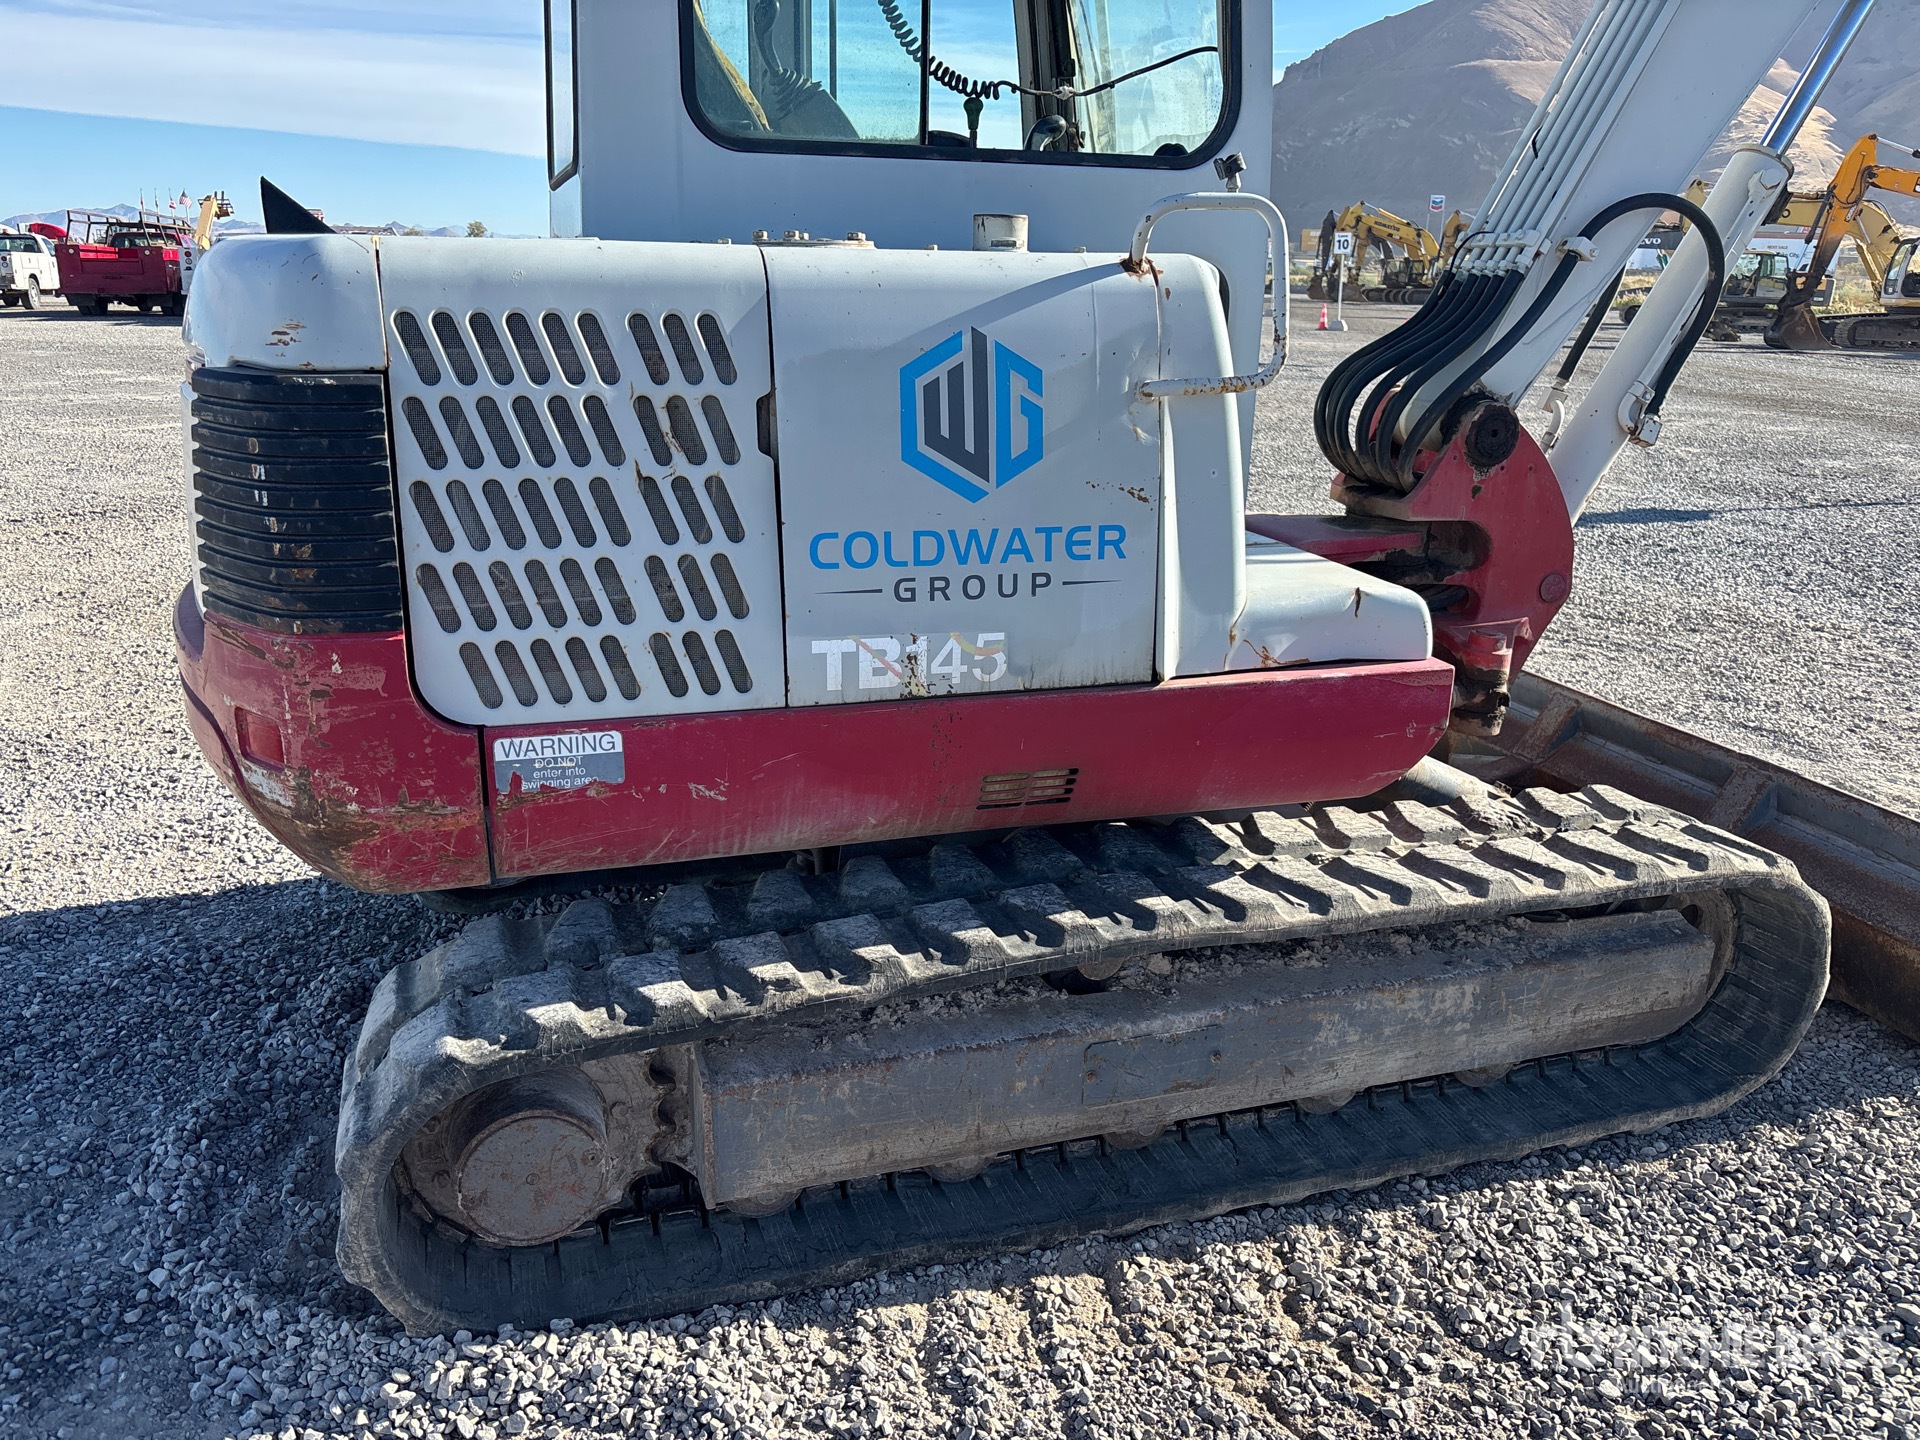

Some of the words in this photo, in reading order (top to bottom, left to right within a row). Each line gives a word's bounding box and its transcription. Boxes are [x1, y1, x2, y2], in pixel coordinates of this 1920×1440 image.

[1337, 239, 1349, 250] 10
[809, 525, 1127, 570] COLDWATER
[893, 572, 1052, 602] GROUP
[811, 632, 1008, 691] TB145
[500, 733, 616, 759] WARNING
[533, 769, 562, 779] enter
[565, 766, 586, 776] into
[535, 758, 554, 768] DO
[557, 756, 583, 767] NOT
